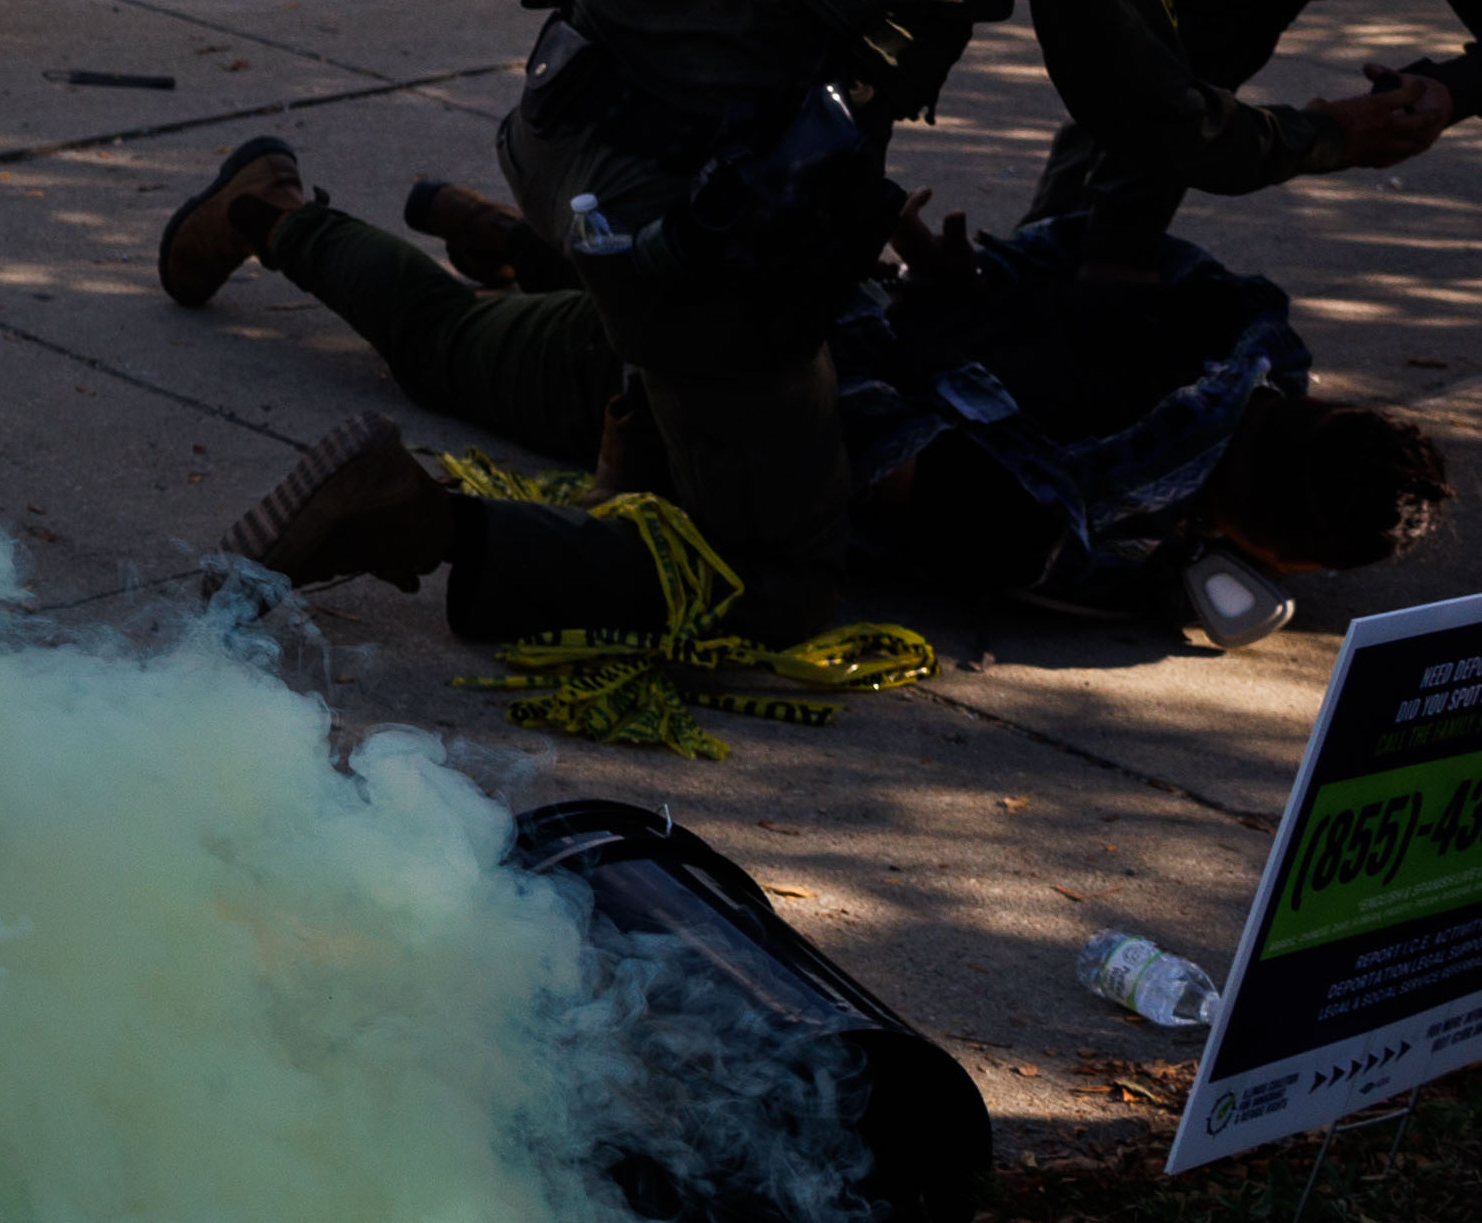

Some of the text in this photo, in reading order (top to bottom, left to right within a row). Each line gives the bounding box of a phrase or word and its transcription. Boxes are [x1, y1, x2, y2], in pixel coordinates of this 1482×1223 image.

[1420, 661, 1455, 690] NEED
[1394, 697, 1422, 724] DID
[1421, 691, 1450, 717] YOU
[1373, 729, 1407, 757] CALL
[1407, 723, 1434, 748] THE
[1355, 943, 1404, 971] REPORT
[1327, 962, 1411, 1000] DEPORTATION
[1317, 1001, 1351, 1022] LEGAL
